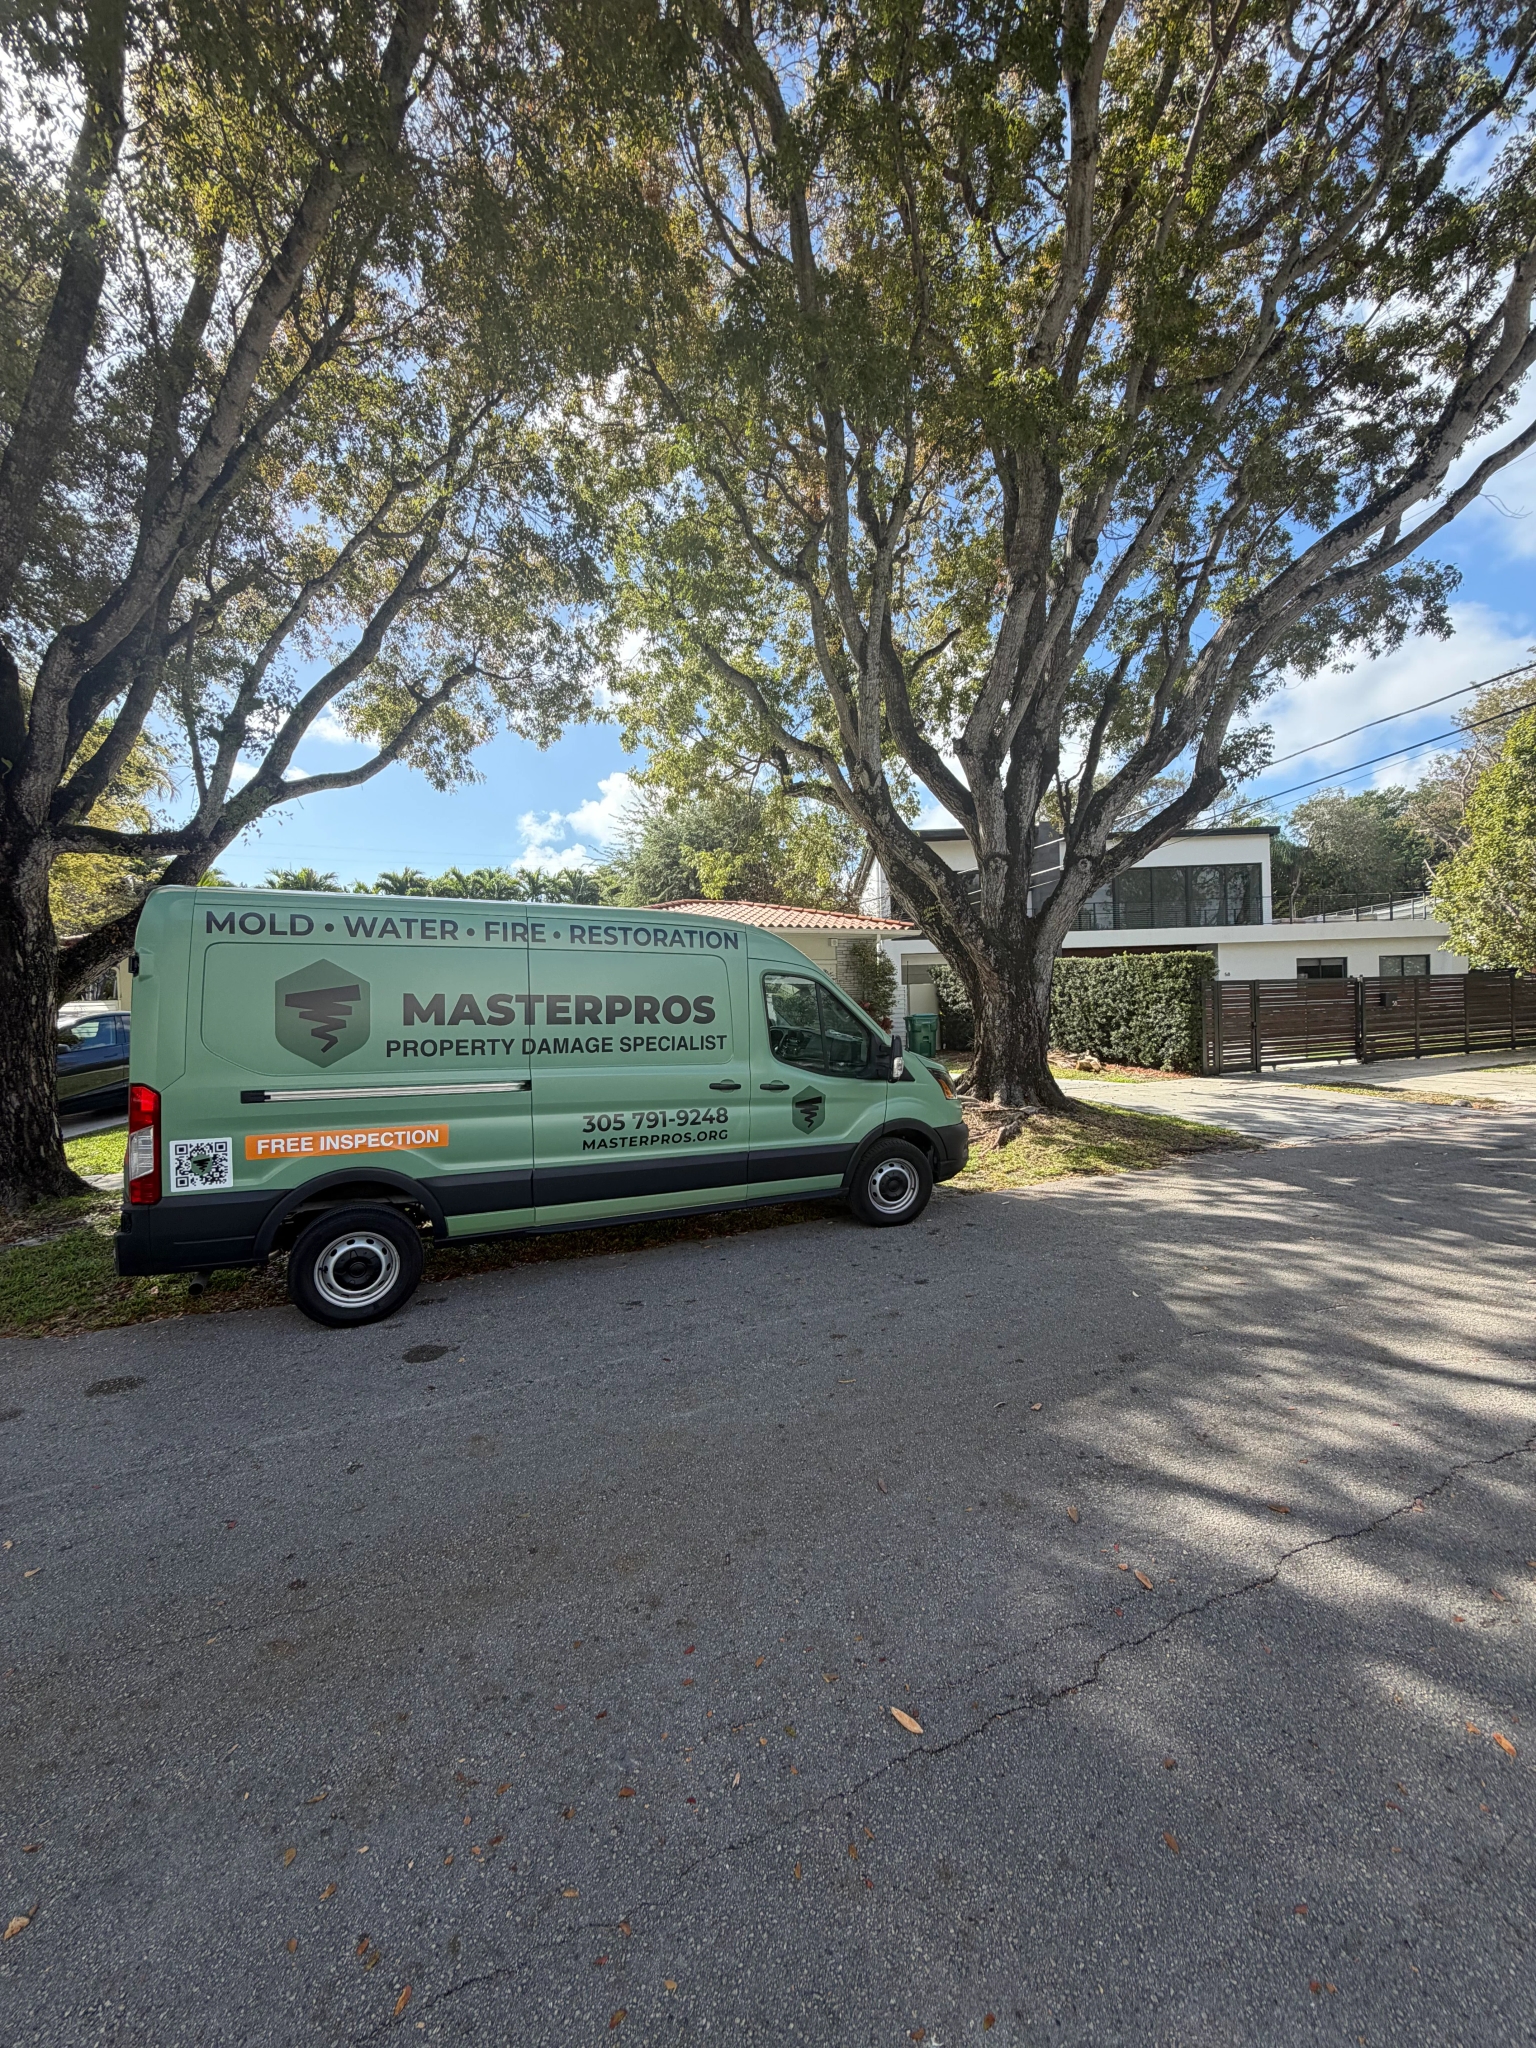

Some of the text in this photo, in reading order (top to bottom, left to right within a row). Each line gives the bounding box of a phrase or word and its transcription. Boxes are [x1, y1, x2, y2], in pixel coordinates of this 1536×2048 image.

[206, 911, 739, 950] MOLD WATER FIRE RESTORATION
[403, 993, 716, 1026] MASTERPROS
[386, 1034, 728, 1057] PROPERTY DAMAGE SPECIALIST
[582, 1107, 729, 1133] 305 791-9248
[257, 1129, 440, 1155] FREE INSPECTION
[582, 1129, 728, 1150] MASTERPROS.ORG
